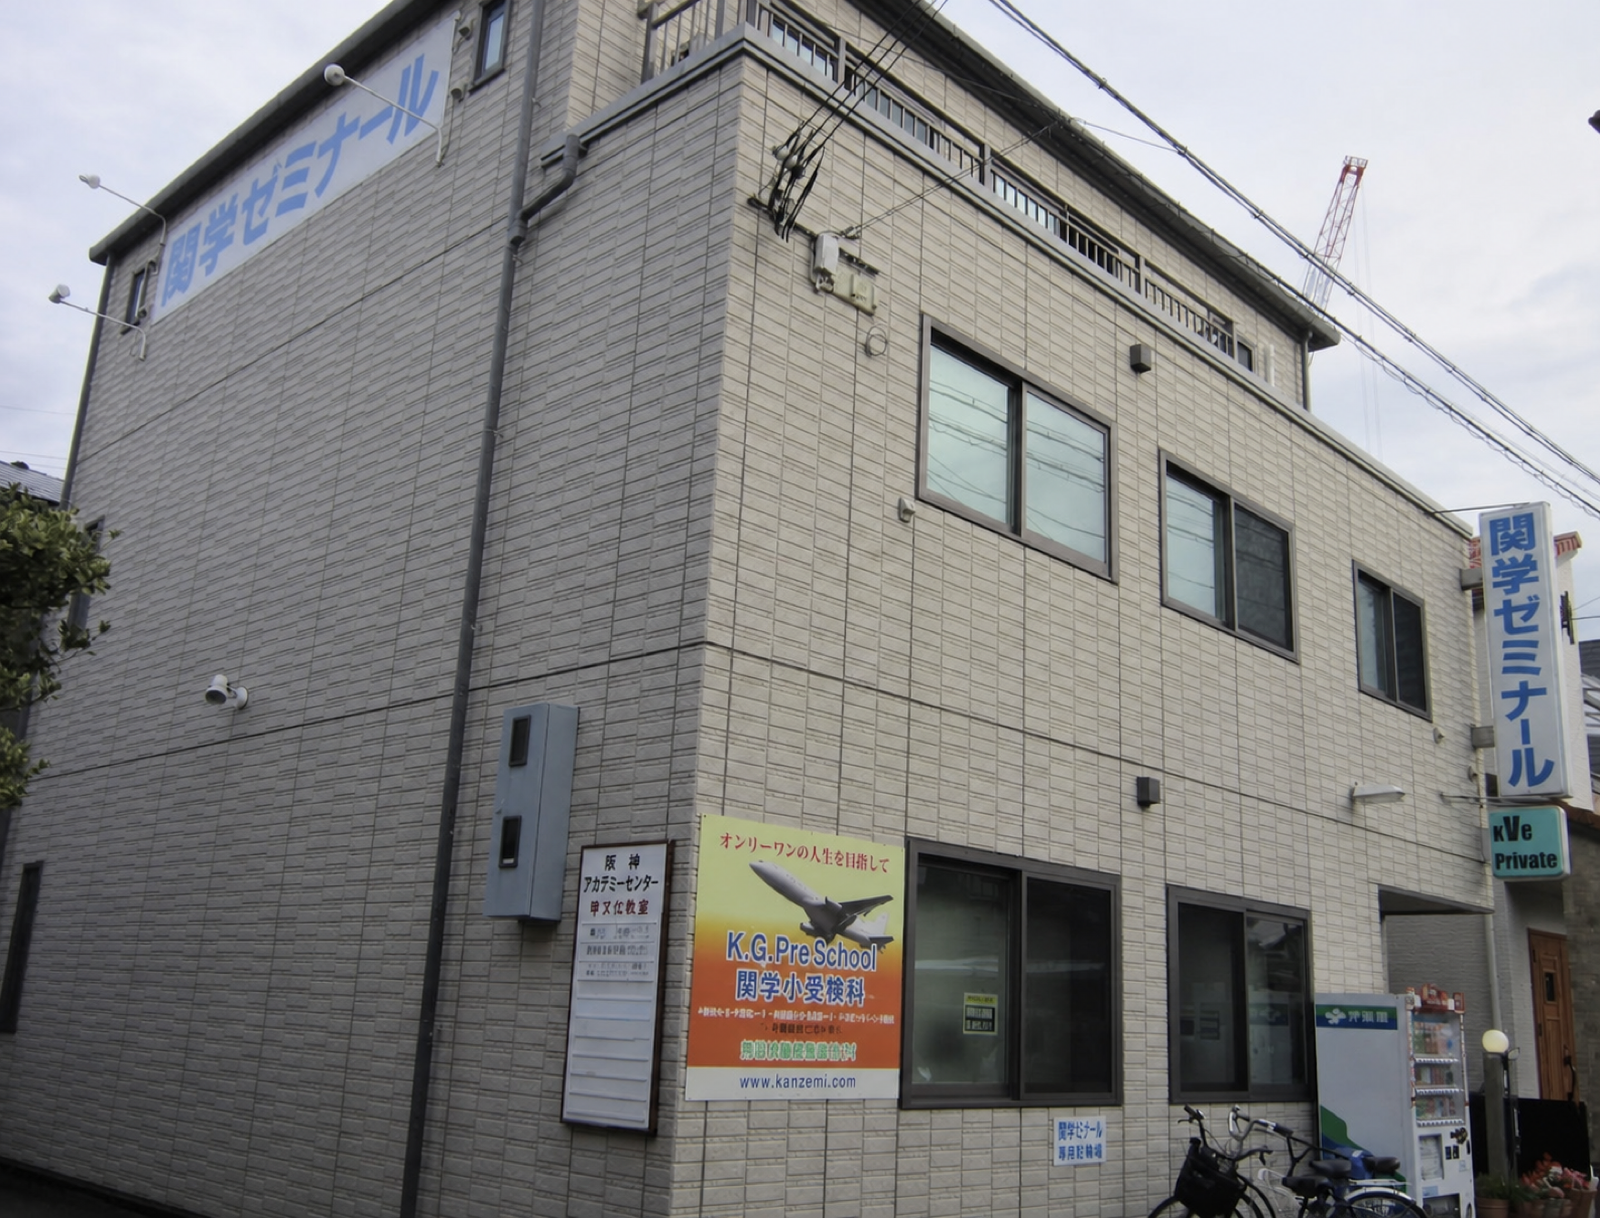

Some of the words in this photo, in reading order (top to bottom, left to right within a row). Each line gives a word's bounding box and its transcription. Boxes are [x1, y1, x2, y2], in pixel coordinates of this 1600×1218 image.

[161, 53, 439, 307] 関学ゼミナール
[1489, 512, 1555, 788] 関学ゼミナール
[720, 832, 890, 873] オンリーワンの人生を目指して
[1495, 852, 1557, 870] Private
[583, 874, 659, 893] アカデミーセンター
[736, 970, 865, 1005] 関学小受検科
[740, 1073, 856, 1089] www.kanzemi.com
